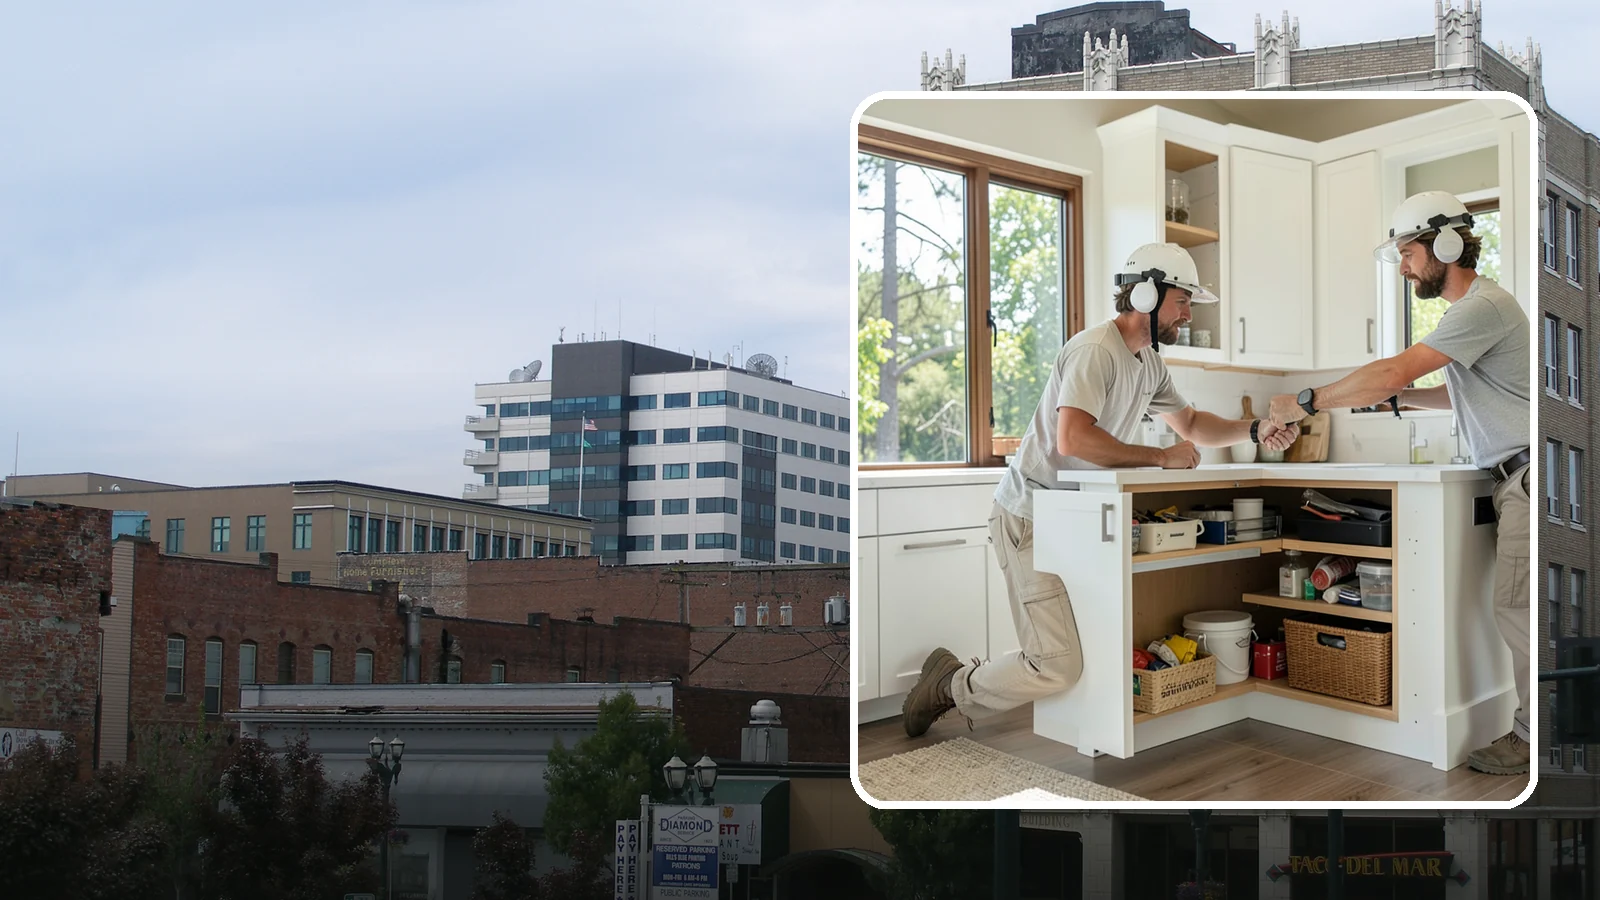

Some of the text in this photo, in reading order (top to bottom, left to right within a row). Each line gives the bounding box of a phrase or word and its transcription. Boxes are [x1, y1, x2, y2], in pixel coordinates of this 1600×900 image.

[370, 566, 427, 576] Furnishers
[660, 818, 713, 833] DIAMOND
[1022, 815, 1070, 828] BUILDING
[616, 824, 625, 893] PAY HERE
[628, 824, 636, 893] PAY HERE
[721, 852, 739, 862] Soup
[671, 862, 701, 870] PATRONS
[1345, 856, 1385, 876] DEL
[1391, 857, 1442, 877] MAR
[660, 889, 710, 898] PUBLIC PARKING
